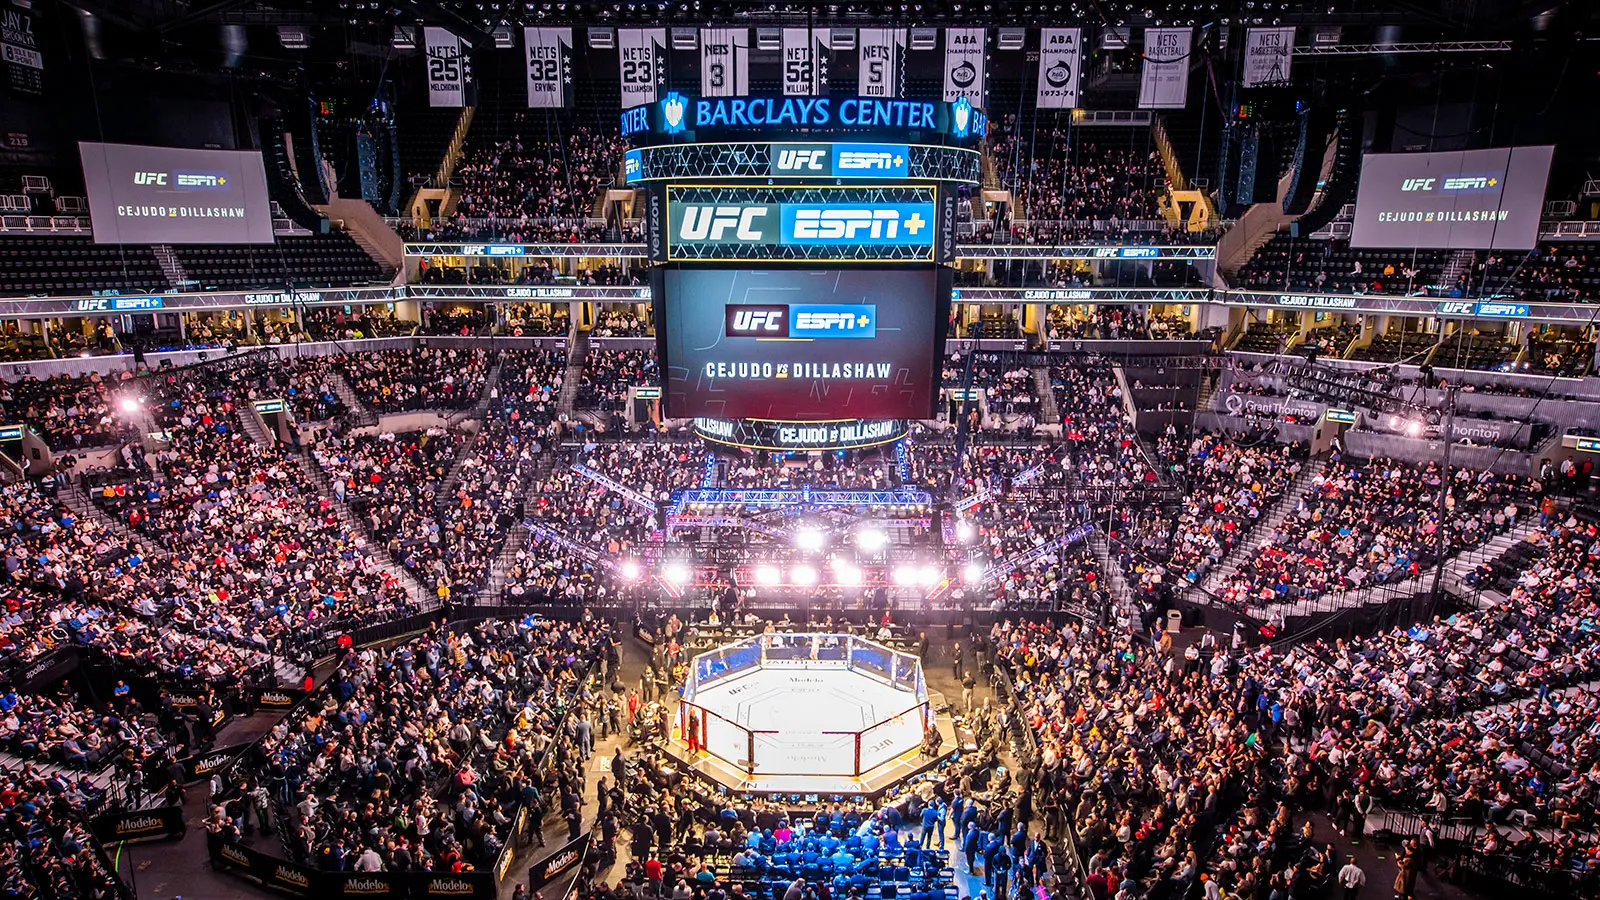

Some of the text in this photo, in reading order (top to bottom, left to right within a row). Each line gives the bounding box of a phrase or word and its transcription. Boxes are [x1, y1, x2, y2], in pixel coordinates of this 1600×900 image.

[954, 35, 977, 44] ABA
[1050, 35, 1073, 44] ABA
[1157, 34, 1178, 47] NETS
[1259, 34, 1280, 46] NETS
[6, 45, 14, 60] 8
[429, 46, 457, 58] NETS
[529, 46, 557, 59] NETS
[623, 47, 651, 60] NETS
[705, 45, 729, 57] NETS
[787, 48, 813, 61] NET
[863, 46, 889, 61] NETS
[1148, 46, 1184, 56] BASKETBALL
[430, 59, 459, 82] 25
[530, 59, 558, 82] 32
[623, 61, 651, 83] 23
[711, 64, 725, 88] 3
[869, 61, 883, 83] 5
[535, 83, 557, 92] ERVING
[623, 85, 653, 93] WILLIAMSON
[866, 85, 884, 95] KIDD
[696, 98, 937, 129] BARCLAYS CENTER
[777, 150, 826, 170] UFC
[133, 171, 168, 186] UFC
[1401, 178, 1437, 192] UFC
[117, 205, 167, 217] CEJUDO
[180, 206, 245, 218] DILLASHAW
[1378, 211, 1423, 222] CEJUDO
[1436, 210, 1509, 222] DILLASHAW
[651, 195, 661, 258] verizon
[679, 206, 769, 241] UFC
[943, 196, 953, 259] verizon
[463, 246, 485, 255] UFC
[1096, 248, 1119, 257] UFC
[245, 293, 273, 304] CEJUDO
[1280, 295, 1308, 305] CEJUDO
[1314, 296, 1355, 308] DILLASHAW
[77, 300, 107, 311] UFC
[1442, 302, 1473, 314] UFC
[732, 311, 783, 331] UFC
[706, 362, 892, 379] CEJUDO VS DILLASHAW
[1246, 400, 1272, 412] Grant
[1273, 403, 1317, 417] Thornton
[780, 427, 828, 443] CEJUDO
[840, 420, 893, 441] DILLASHAW
[1452, 423, 1500, 438] hornton
[263, 692, 288, 703] Modelo
[200, 754, 232, 770] Modelo
[120, 816, 158, 831] Modelo
[548, 850, 576, 873] Modelo
[279, 865, 306, 883] Modelo
[348, 878, 384, 891] Modelo
[432, 878, 469, 891] Modelo
